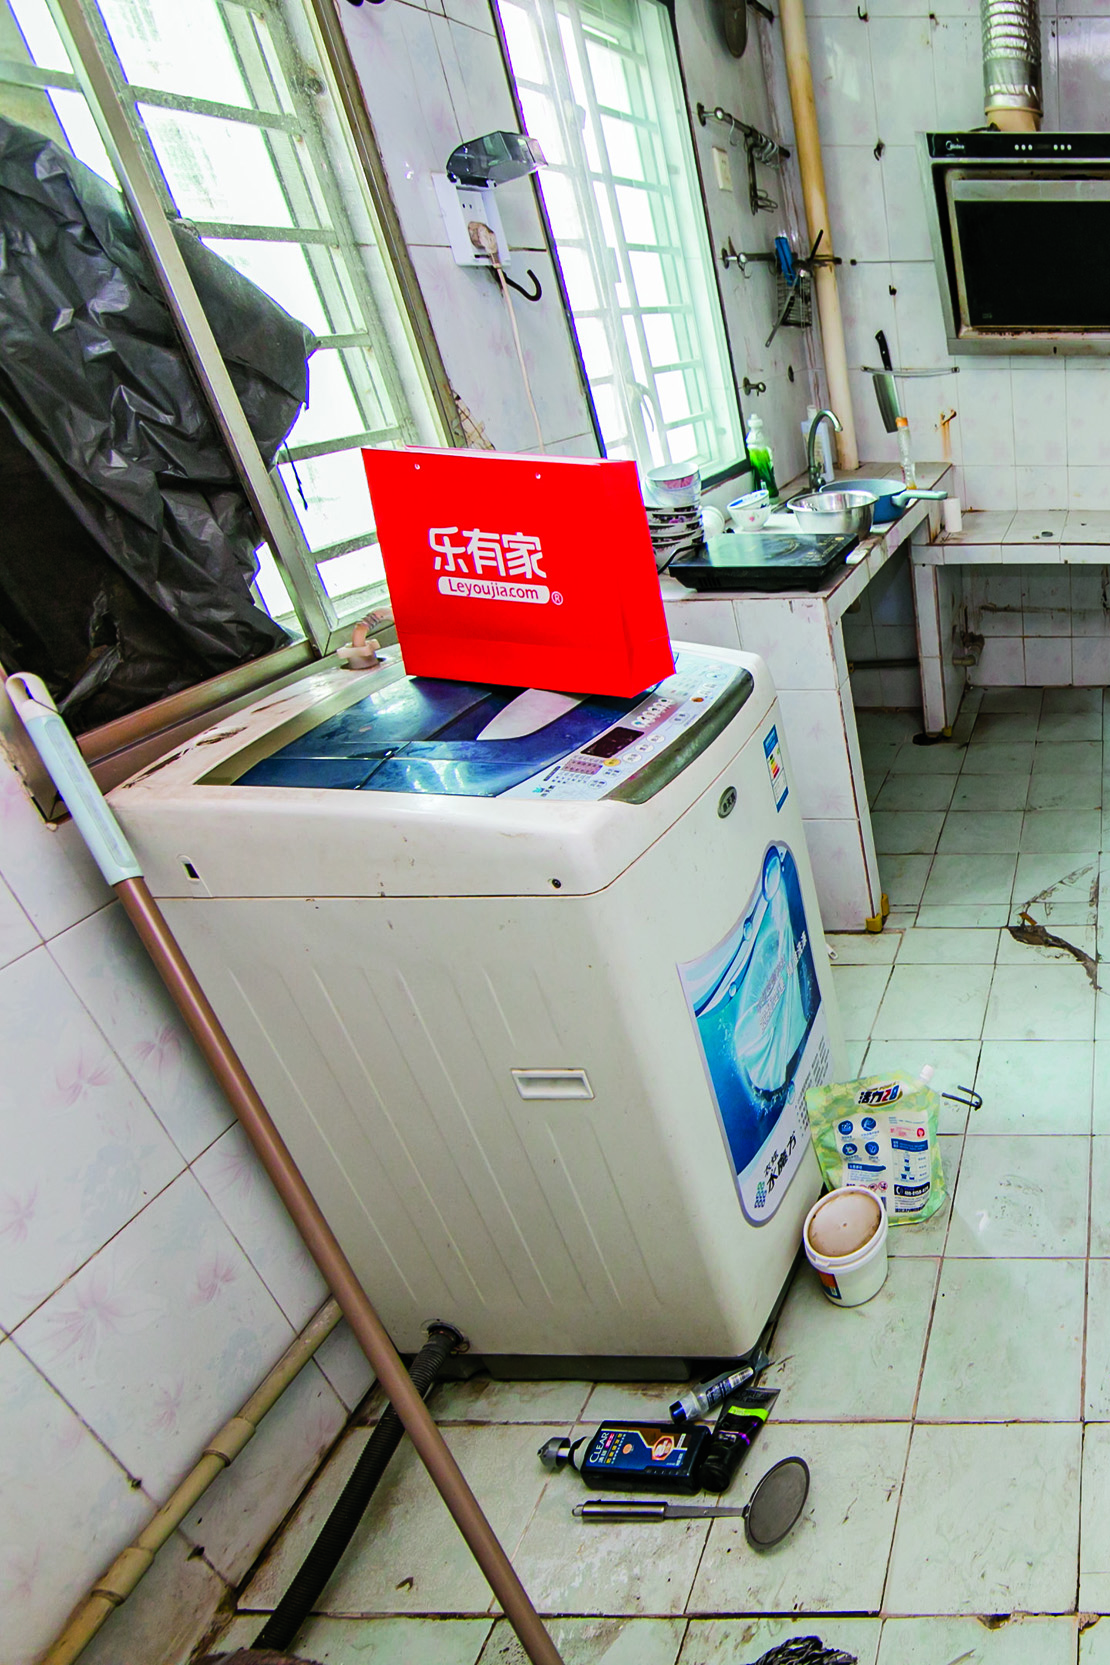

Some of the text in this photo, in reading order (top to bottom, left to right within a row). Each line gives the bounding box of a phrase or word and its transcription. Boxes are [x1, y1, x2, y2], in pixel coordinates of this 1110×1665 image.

[428, 526, 547, 579] 乐有家
[447, 578, 540, 600] Leyoujia.com
[767, 1131, 797, 1194] 水魔方
[589, 1432, 610, 1463] CLEAR
